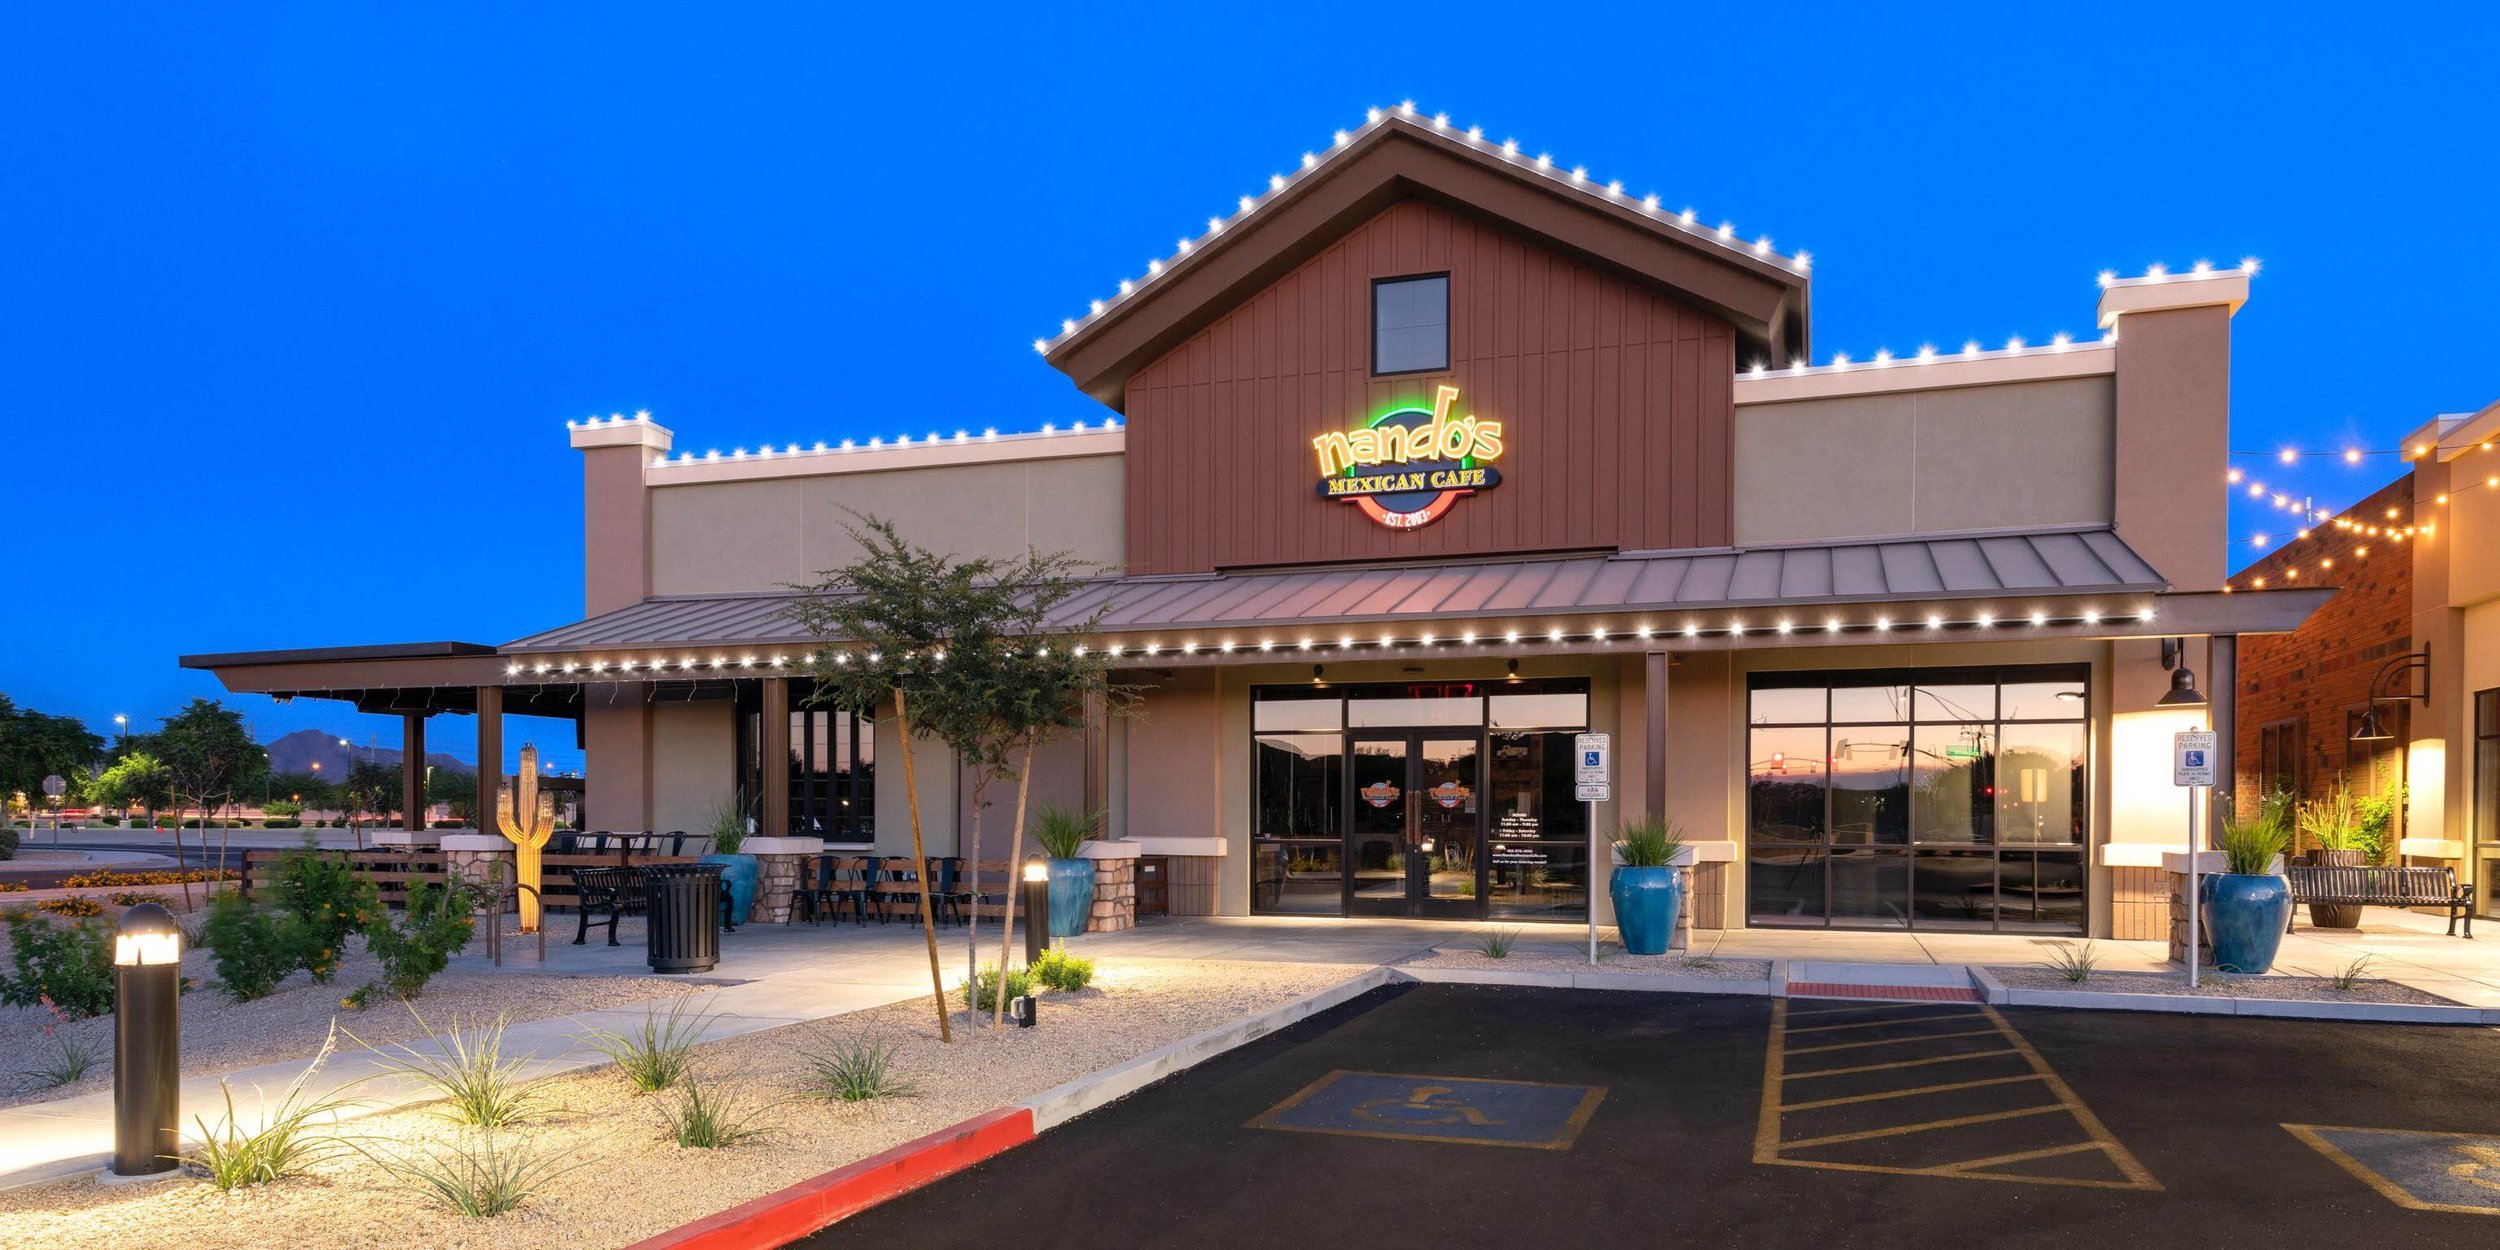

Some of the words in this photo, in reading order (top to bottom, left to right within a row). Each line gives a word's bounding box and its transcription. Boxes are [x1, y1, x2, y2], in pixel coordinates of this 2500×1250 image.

[1313, 385, 1503, 477] nando's
[1328, 472, 1425, 495] MEXICAN
[1431, 468, 1486, 487] CAFE
[1405, 509, 1429, 526] 2003
